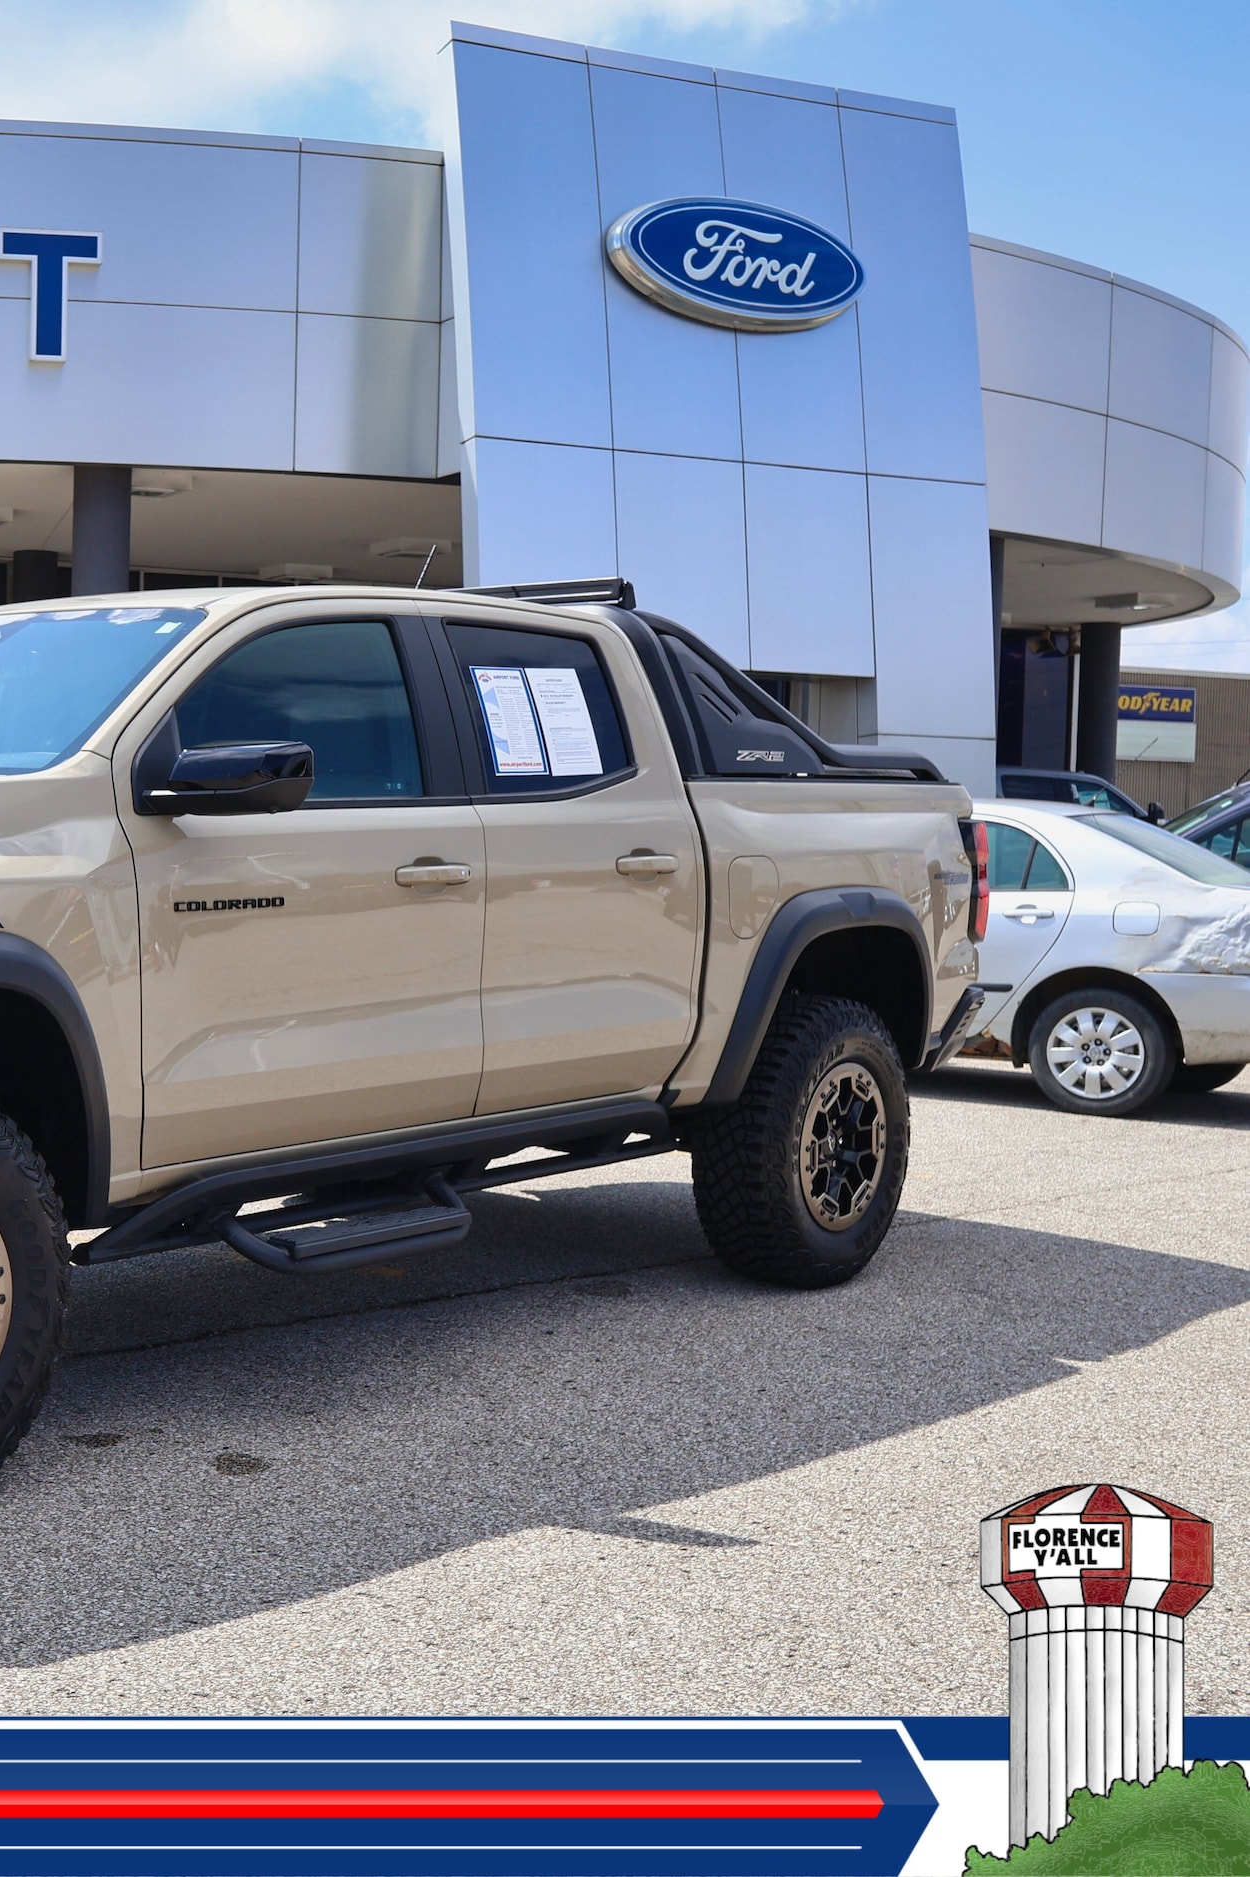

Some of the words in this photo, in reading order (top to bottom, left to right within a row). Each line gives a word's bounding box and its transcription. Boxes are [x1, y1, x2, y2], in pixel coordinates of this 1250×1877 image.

[683, 220, 817, 297] Ford
[1118, 695, 1193, 713] ODYEAR
[736, 750, 784, 762] ZR2
[173, 896, 285, 912] COLORADO
